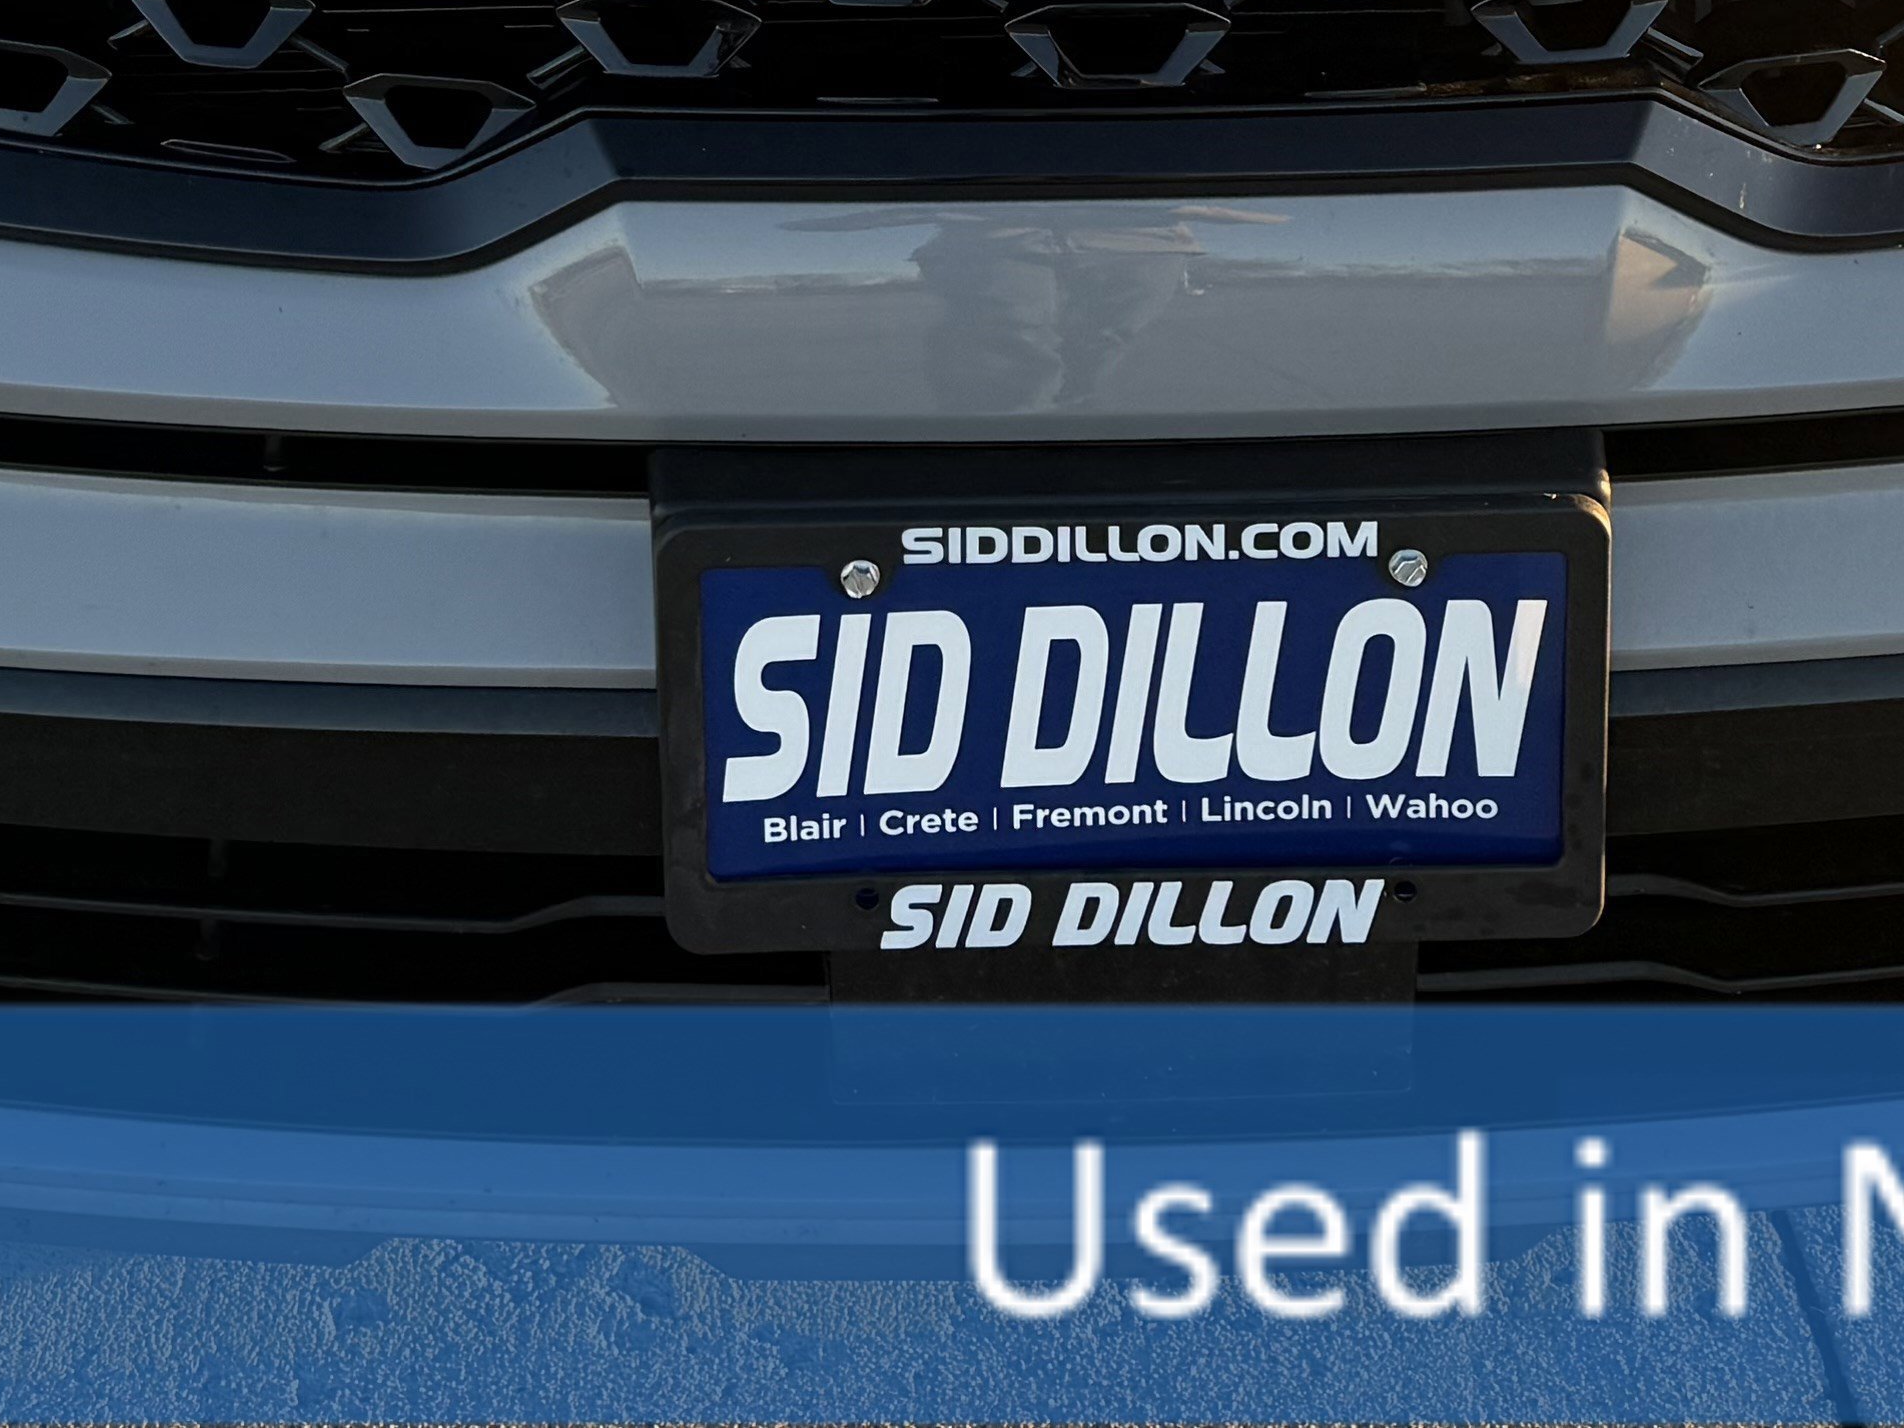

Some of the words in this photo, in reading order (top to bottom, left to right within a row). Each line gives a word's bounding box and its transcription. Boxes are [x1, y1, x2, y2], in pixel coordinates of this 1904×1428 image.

[900, 520, 1379, 565] SIDDILLON.COM
[722, 610, 972, 803] SID
[1000, 598, 1548, 788] DILLON
[762, 814, 848, 843] Blair
[879, 808, 980, 836] Crete
[1012, 798, 1169, 830] Fremont
[1201, 792, 1334, 822] Lincoln
[1365, 792, 1499, 819] Wahoo
[880, 883, 1032, 950] SID
[1052, 878, 1385, 946] DILLON
